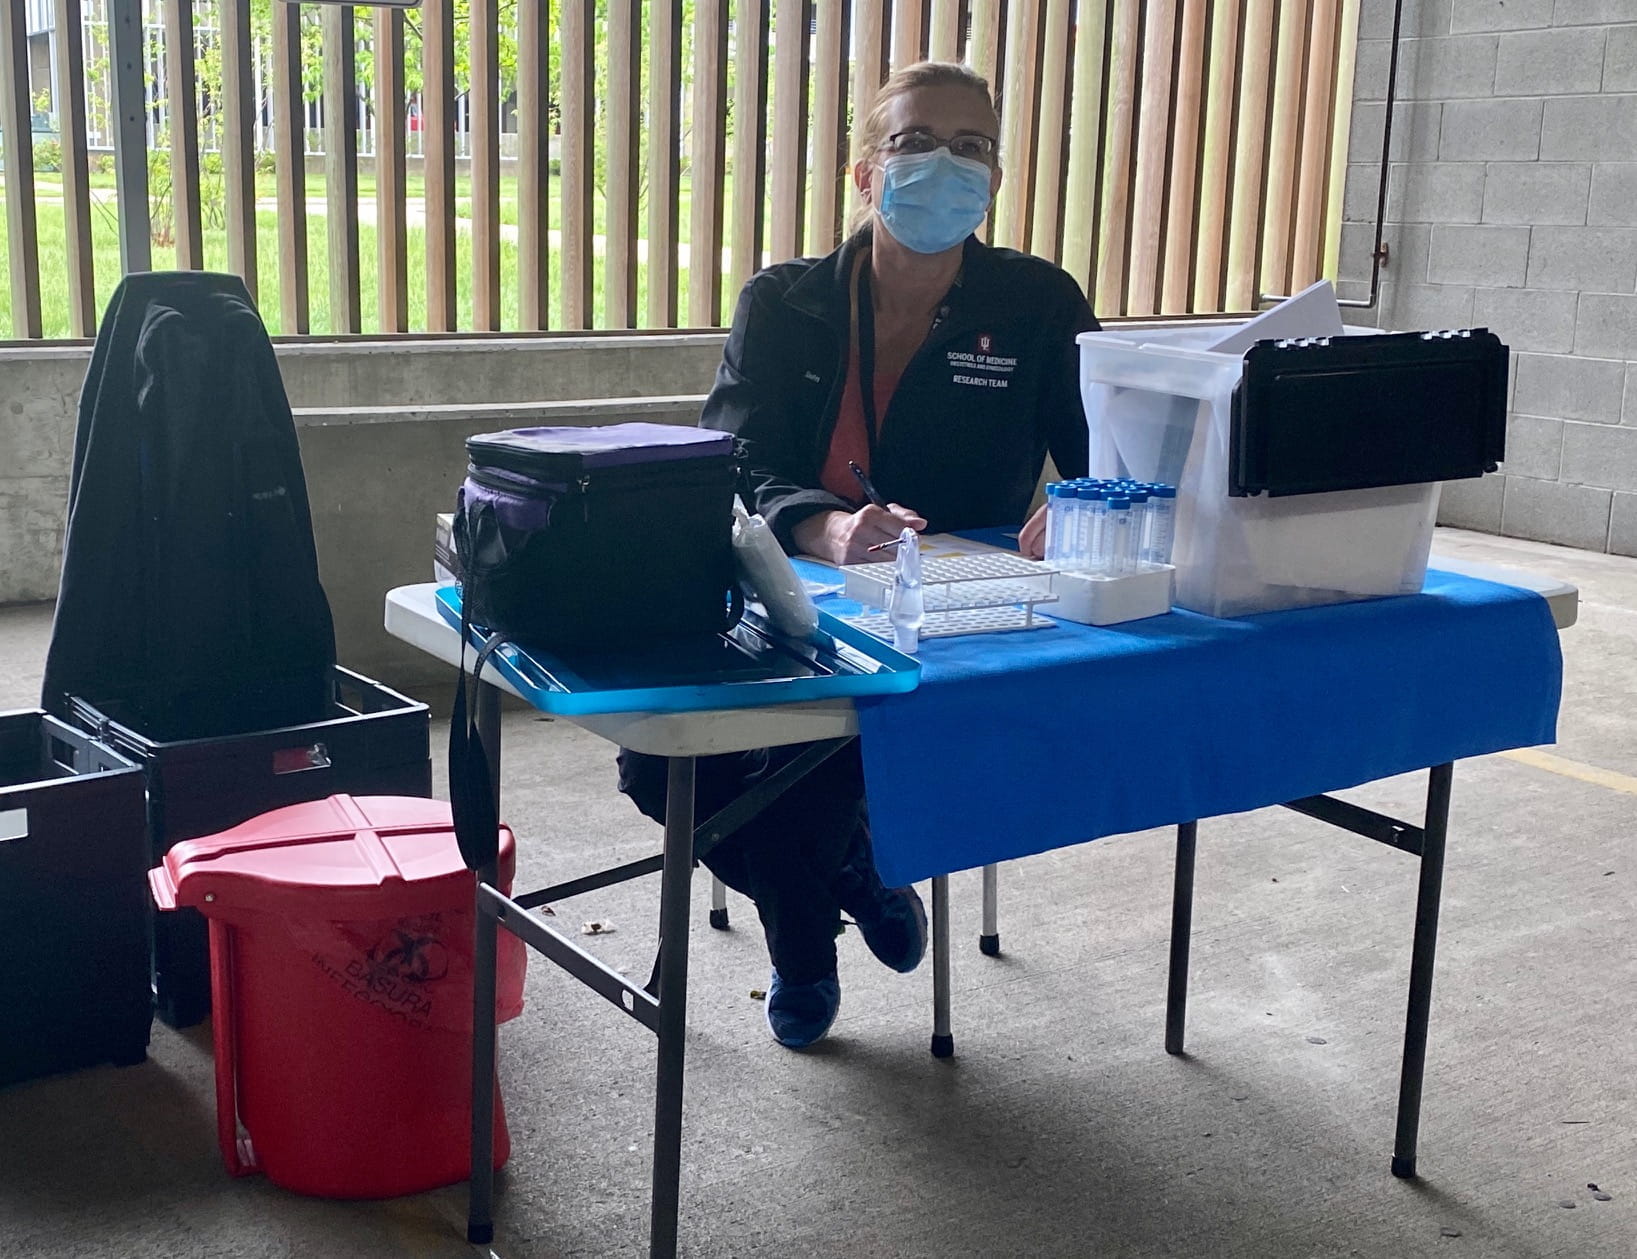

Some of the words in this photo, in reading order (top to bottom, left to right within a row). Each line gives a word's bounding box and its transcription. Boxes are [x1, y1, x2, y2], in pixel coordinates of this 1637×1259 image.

[947, 352, 976, 362] SCHOOL
[976, 355, 985, 363] OF
[986, 356, 1017, 366] MEDICINE
[953, 375, 987, 386] RESEARCH
[989, 379, 1008, 387] TEAM
[344, 959, 433, 1018] BASURA
